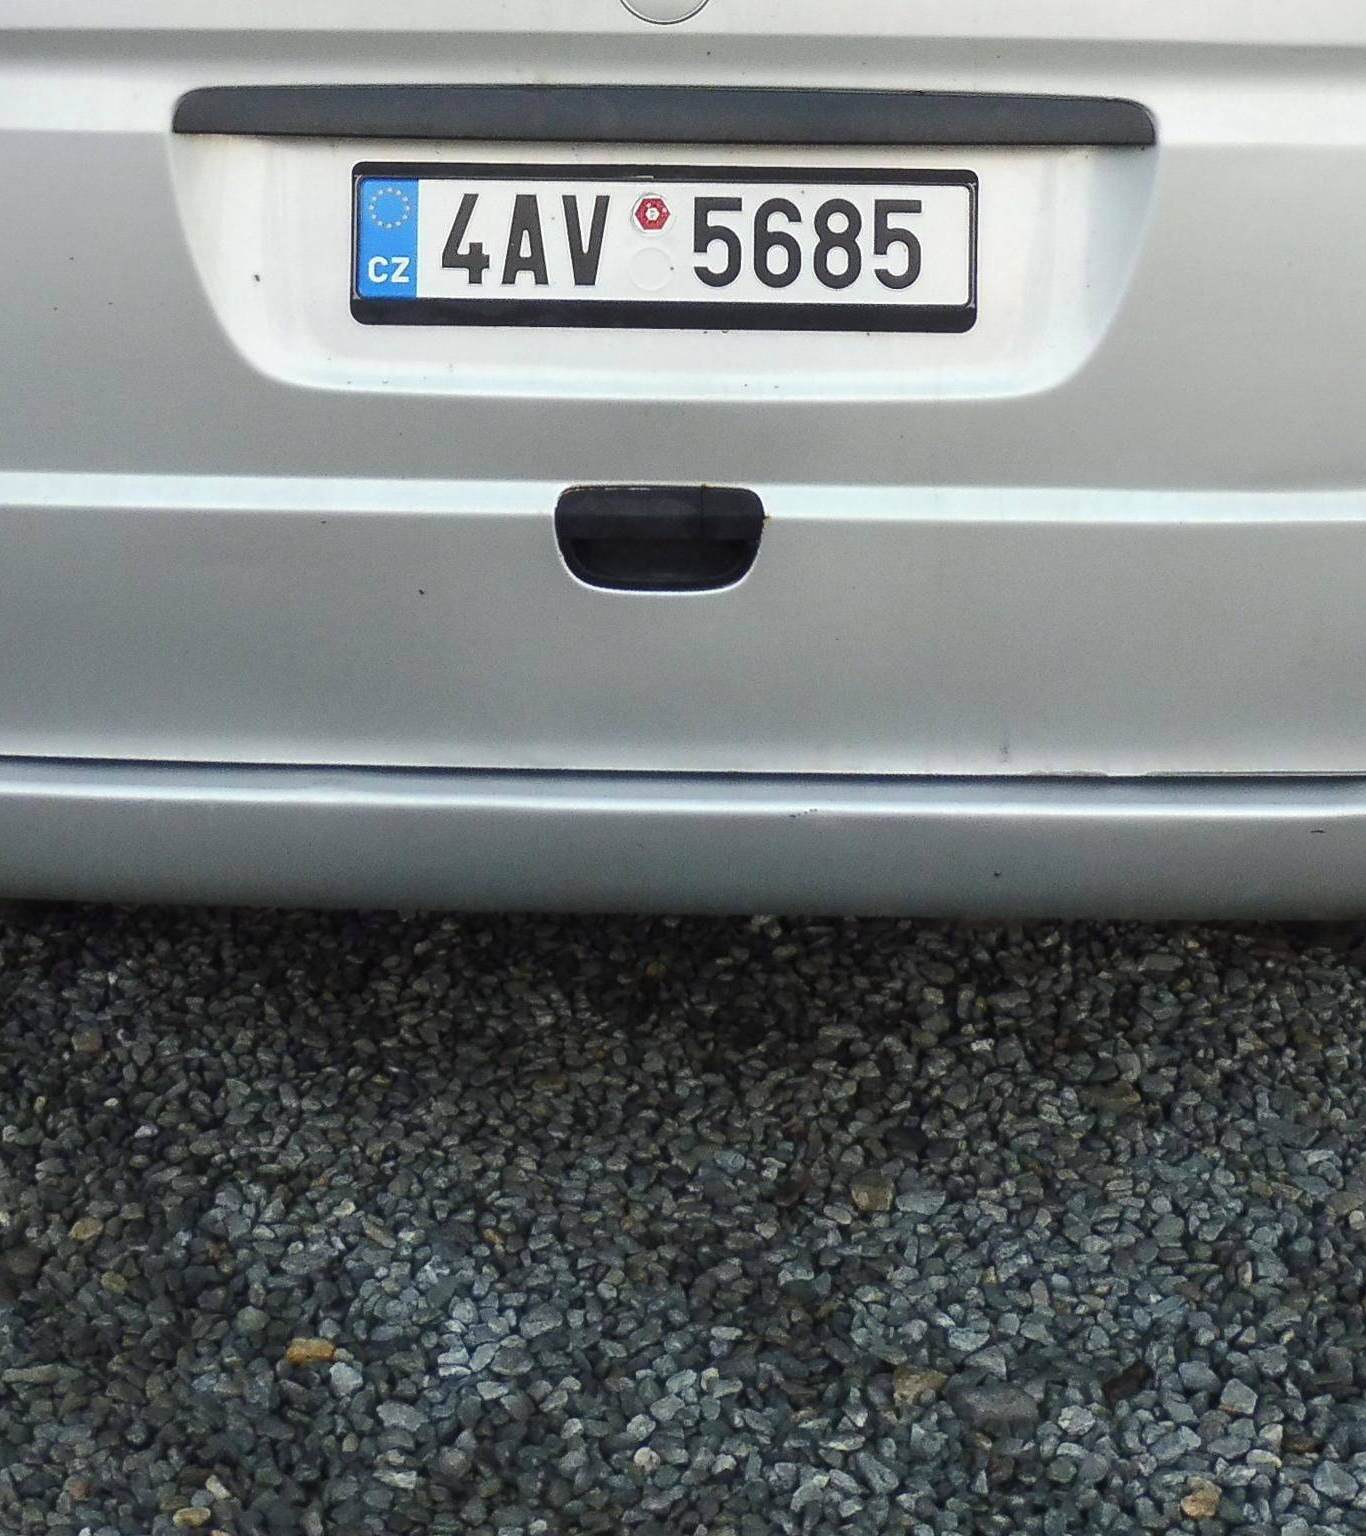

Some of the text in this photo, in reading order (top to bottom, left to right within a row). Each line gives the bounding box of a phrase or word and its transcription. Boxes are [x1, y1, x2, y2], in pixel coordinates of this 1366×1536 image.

[368, 256, 410, 283] CZ
[442, 193, 923, 290] 4AV 5685
